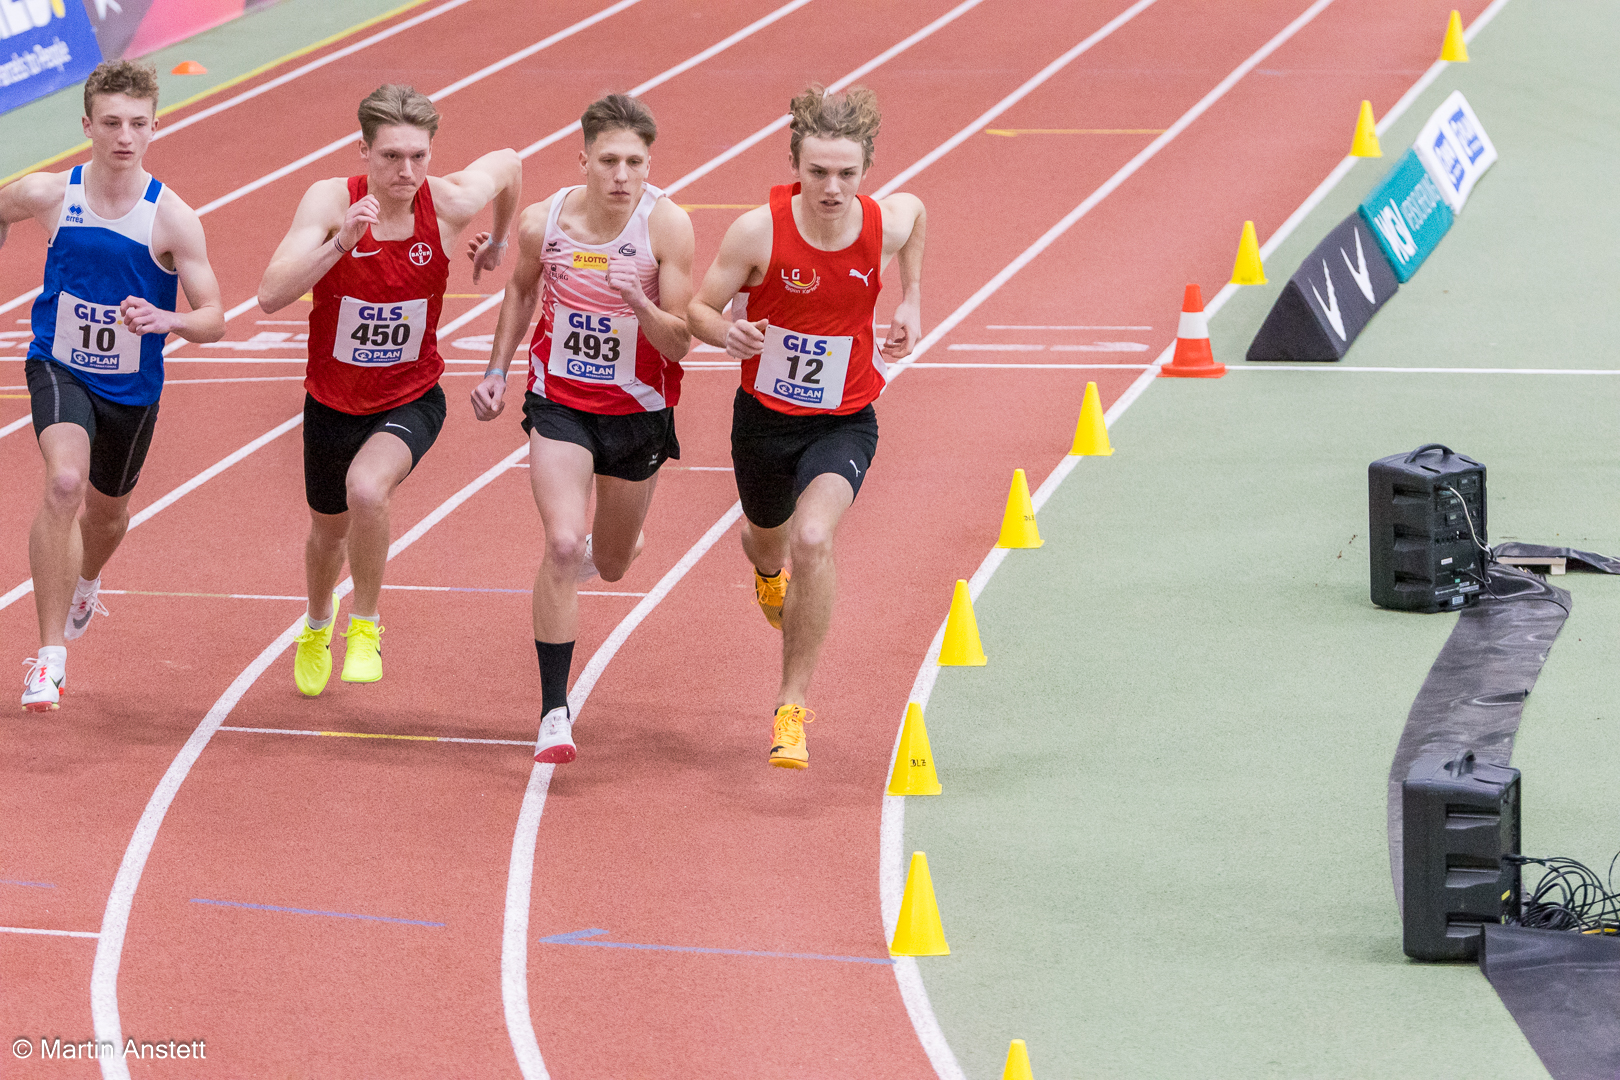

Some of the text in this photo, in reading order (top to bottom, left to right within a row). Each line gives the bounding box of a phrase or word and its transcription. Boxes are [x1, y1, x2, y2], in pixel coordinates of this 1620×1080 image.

[584, 256, 607, 264] LOTTO
[79, 324, 116, 352] 10
[351, 323, 411, 347] 450
[563, 331, 621, 362] 493
[373, 350, 401, 359] PLAN
[90, 356, 117, 365] PLAN
[586, 365, 613, 375] PLAN
[787, 355, 824, 385] 12
[794, 387, 822, 398] PLAN
